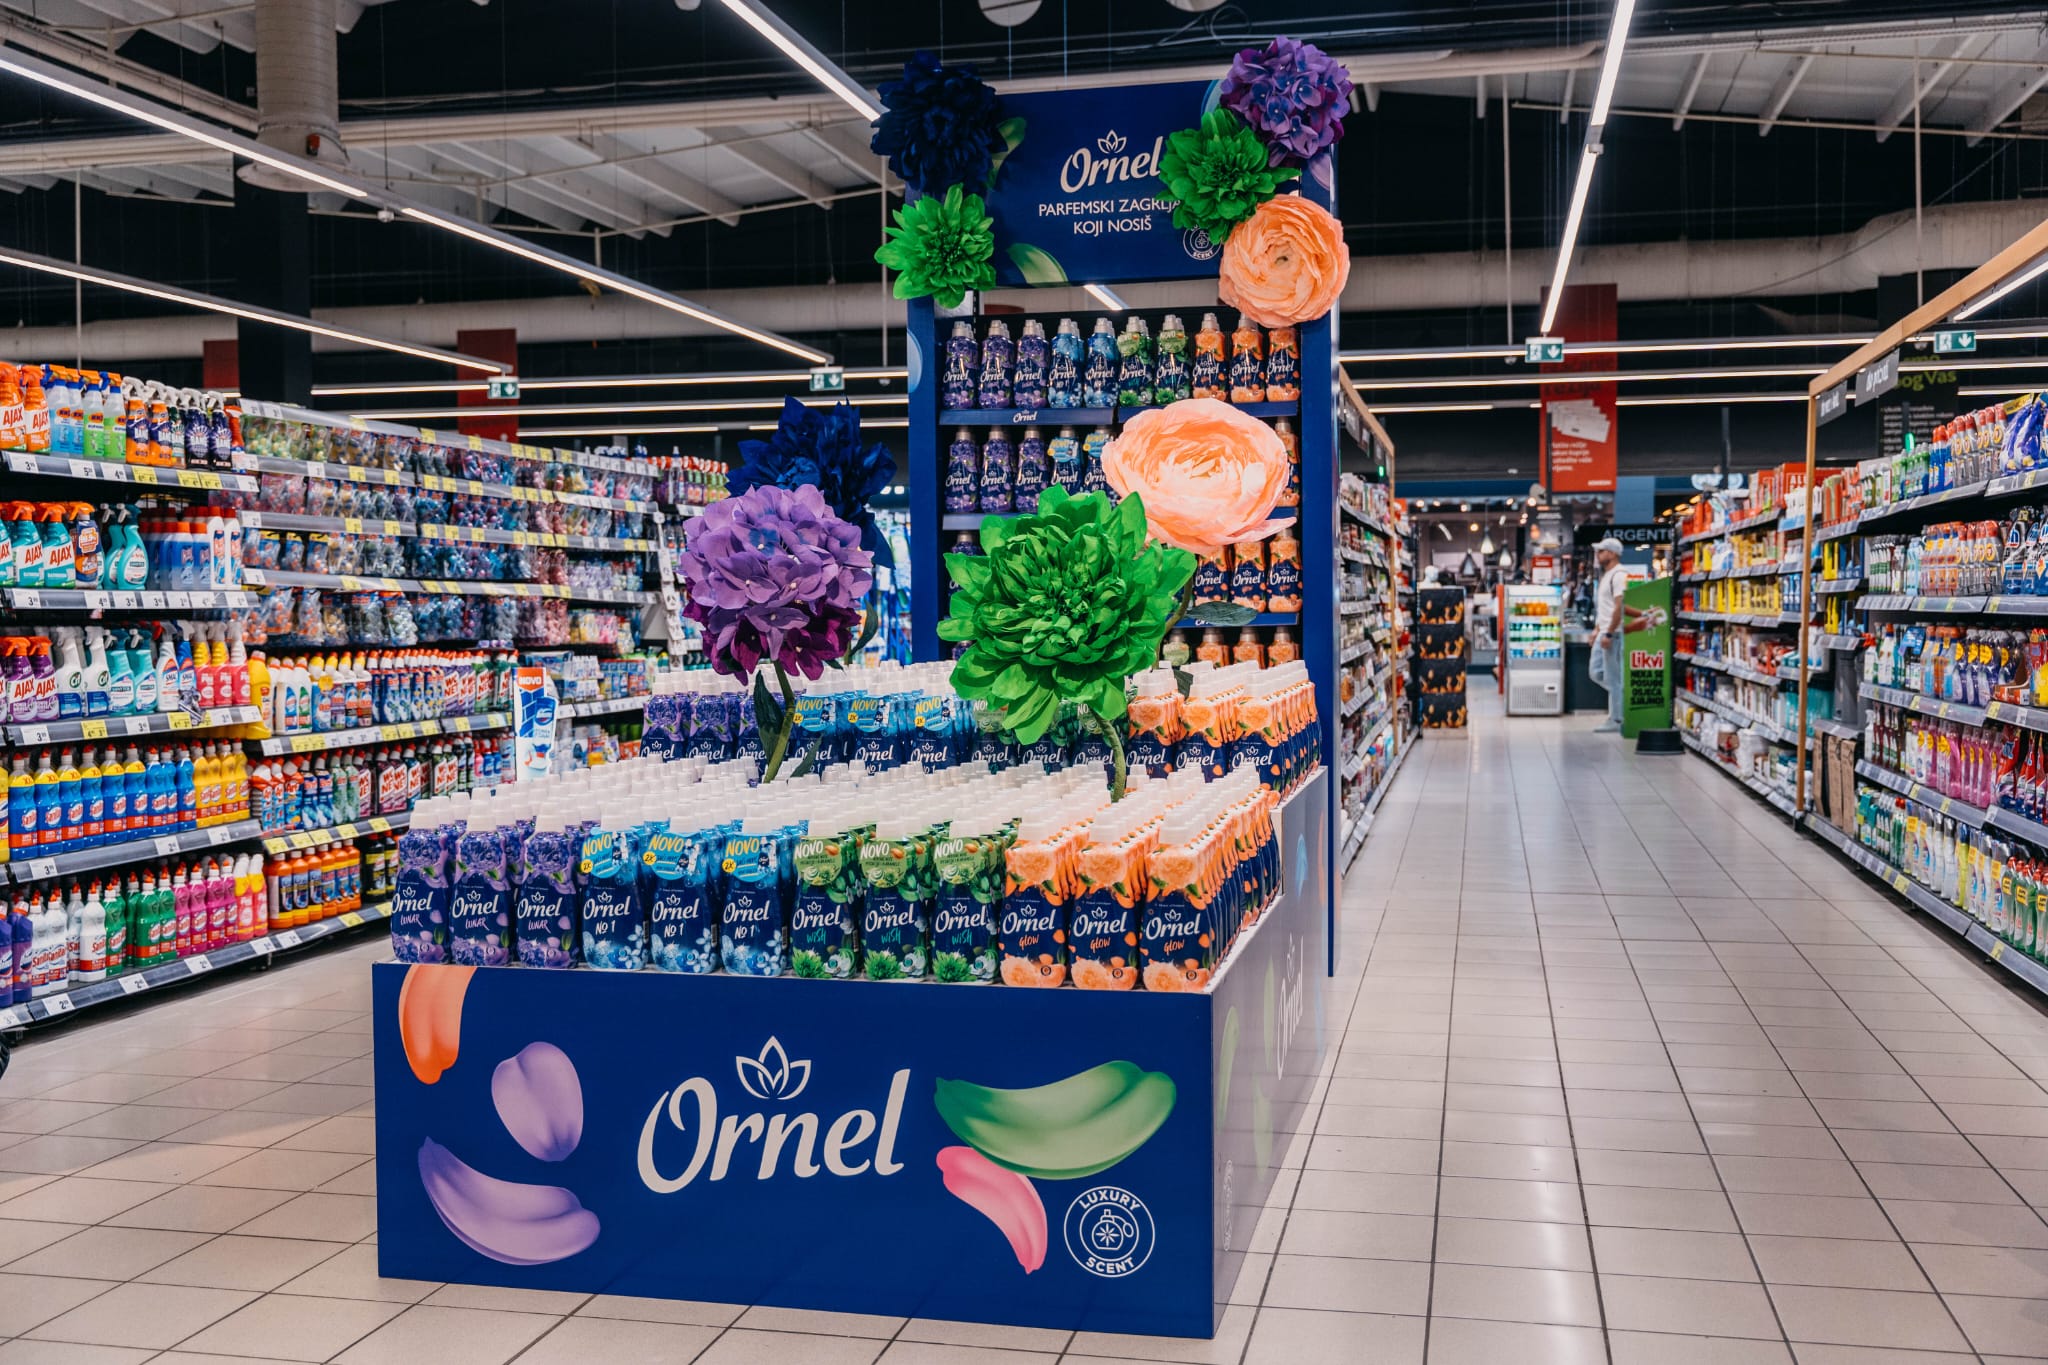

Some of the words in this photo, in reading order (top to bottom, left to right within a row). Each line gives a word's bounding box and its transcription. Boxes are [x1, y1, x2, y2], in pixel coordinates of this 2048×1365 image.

[1060, 136, 1163, 193] Ornel
[1038, 200, 1114, 217] PARFEMSKI
[1073, 221, 1103, 237] KOJI
[1108, 215, 1152, 232] NOSIŠ
[3, 407, 23, 426] AJAX
[1012, 411, 1038, 423] Ornel
[25, 544, 42, 564] AJAX
[50, 547, 71, 566] AJAX
[1195, 573, 1222, 587] Ornel
[1233, 573, 1261, 586] Ornel
[1270, 572, 1299, 585] Ornel
[14, 678, 34, 698] AJAX
[36, 677, 55, 697] AJAX
[796, 700, 823, 711] NOVO
[852, 700, 878, 711] NOVO
[916, 697, 942, 714] NOVO
[583, 834, 612, 857] NOVO
[649, 834, 685, 852] NOVO
[726, 838, 760, 857] NOVO
[794, 841, 824, 859] NOVO
[861, 843, 889, 859] NOVO
[934, 839, 964, 859] NOVO
[392, 893, 433, 914] Ornel
[452, 894, 499, 917] Ornel
[517, 896, 563, 918] Ornel
[583, 896, 631, 920] Ornel
[652, 898, 700, 923] Ornel
[723, 900, 771, 924] Ornel
[611, 920, 616, 933] 1
[792, 905, 841, 931] Ornel
[865, 903, 915, 932] Ornel
[935, 905, 988, 933] Ornel
[1003, 910, 1055, 934] Ornel
[1073, 912, 1127, 937] Ornel
[1146, 914, 1201, 940] Ornel
[679, 922, 684, 937] 1
[750, 924, 755, 938] 1
[1277, 936, 1304, 1081] Ornel
[637, 1069, 911, 1194] Ornel
[1079, 1190, 1140, 1211] LUXURY
[1086, 1257, 1135, 1273] SCENT
